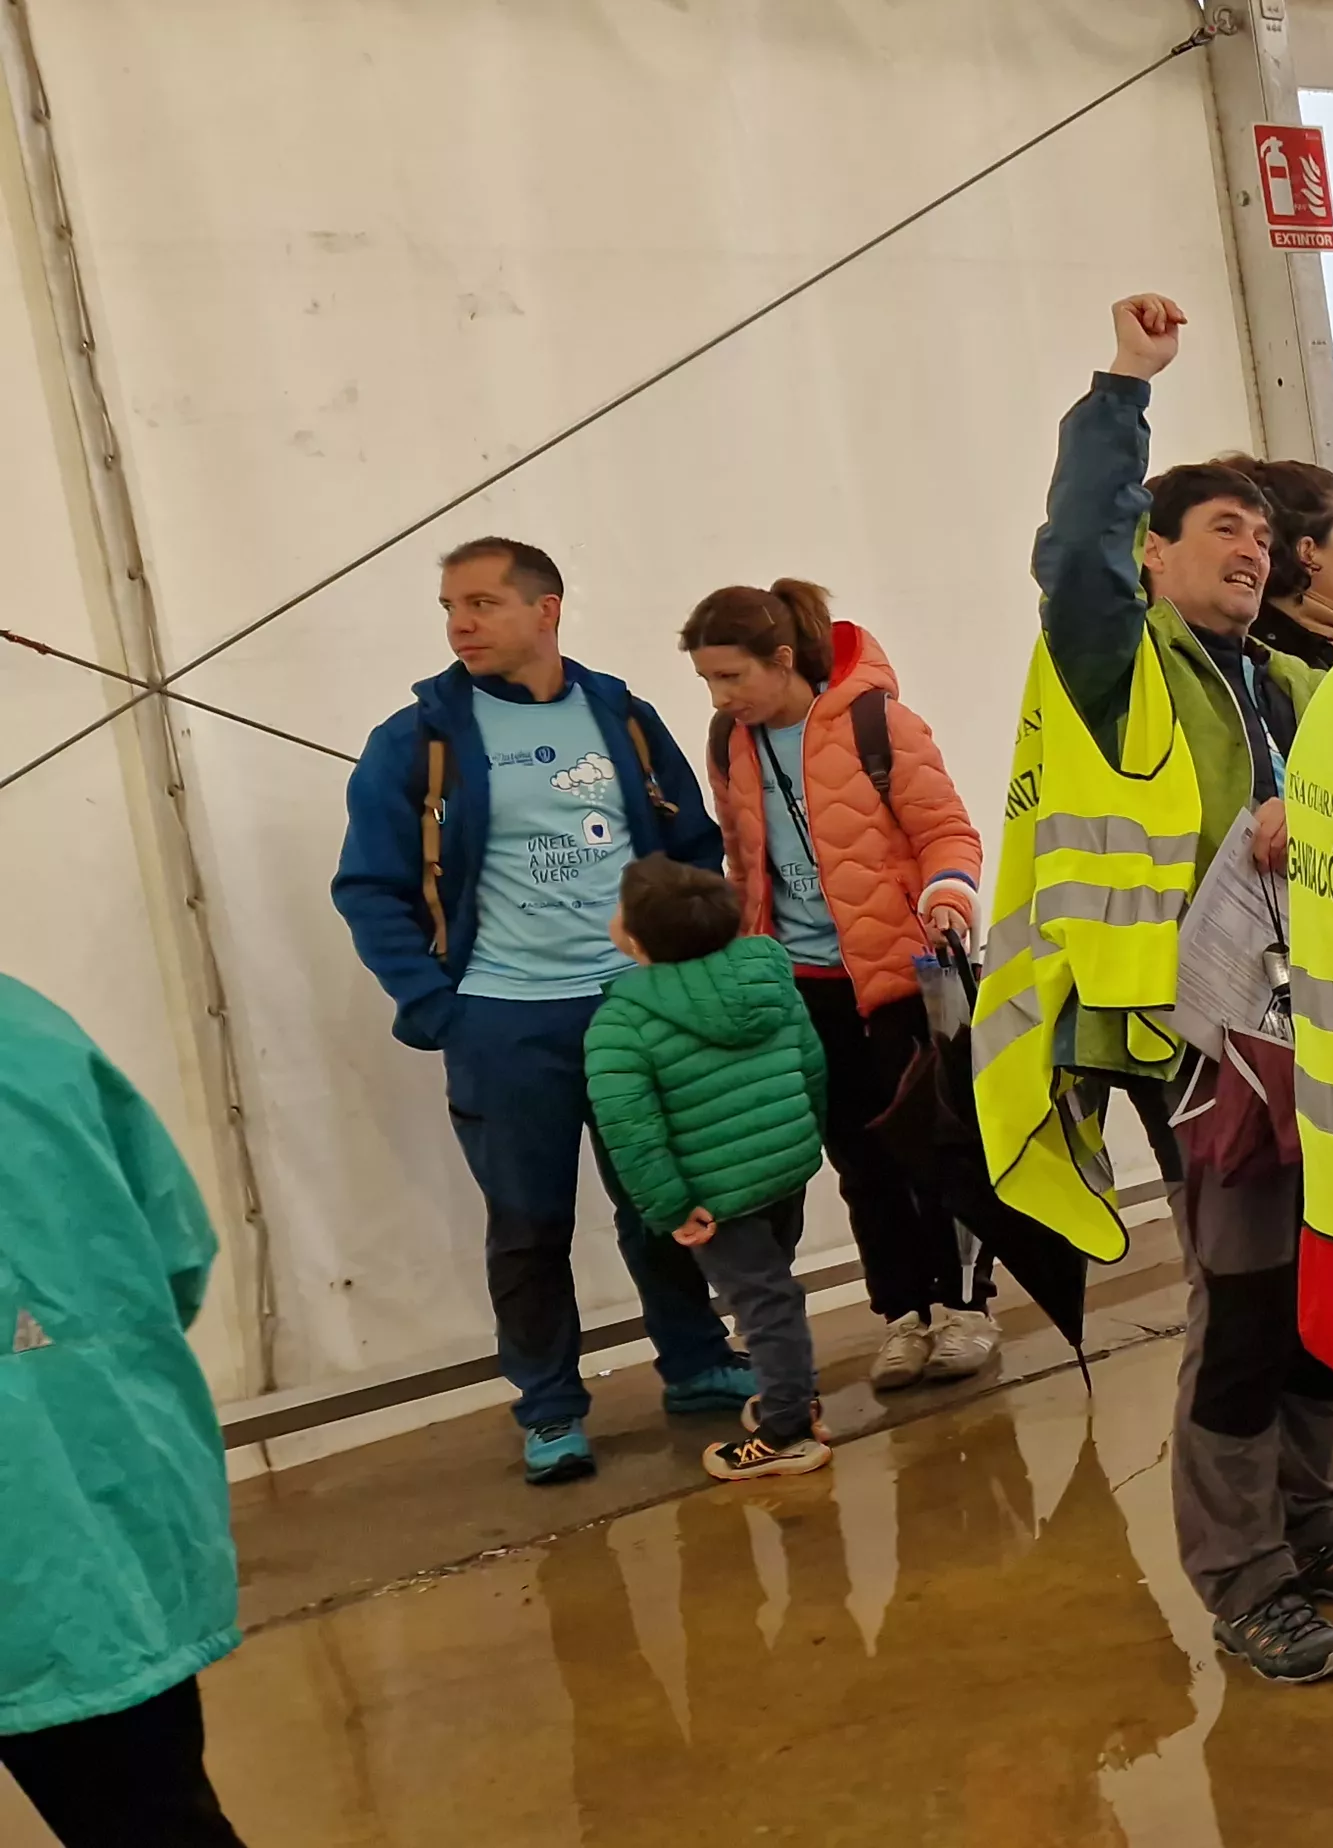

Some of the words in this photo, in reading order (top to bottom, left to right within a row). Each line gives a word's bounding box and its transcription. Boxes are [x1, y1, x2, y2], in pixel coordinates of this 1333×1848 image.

[1274, 232, 1333, 246] EXTINTOR
[528, 834, 577, 852] ÚNETE
[529, 854, 539, 869] A
[545, 847, 608, 867] NUESTRO
[532, 864, 579, 885] SUEÑO
